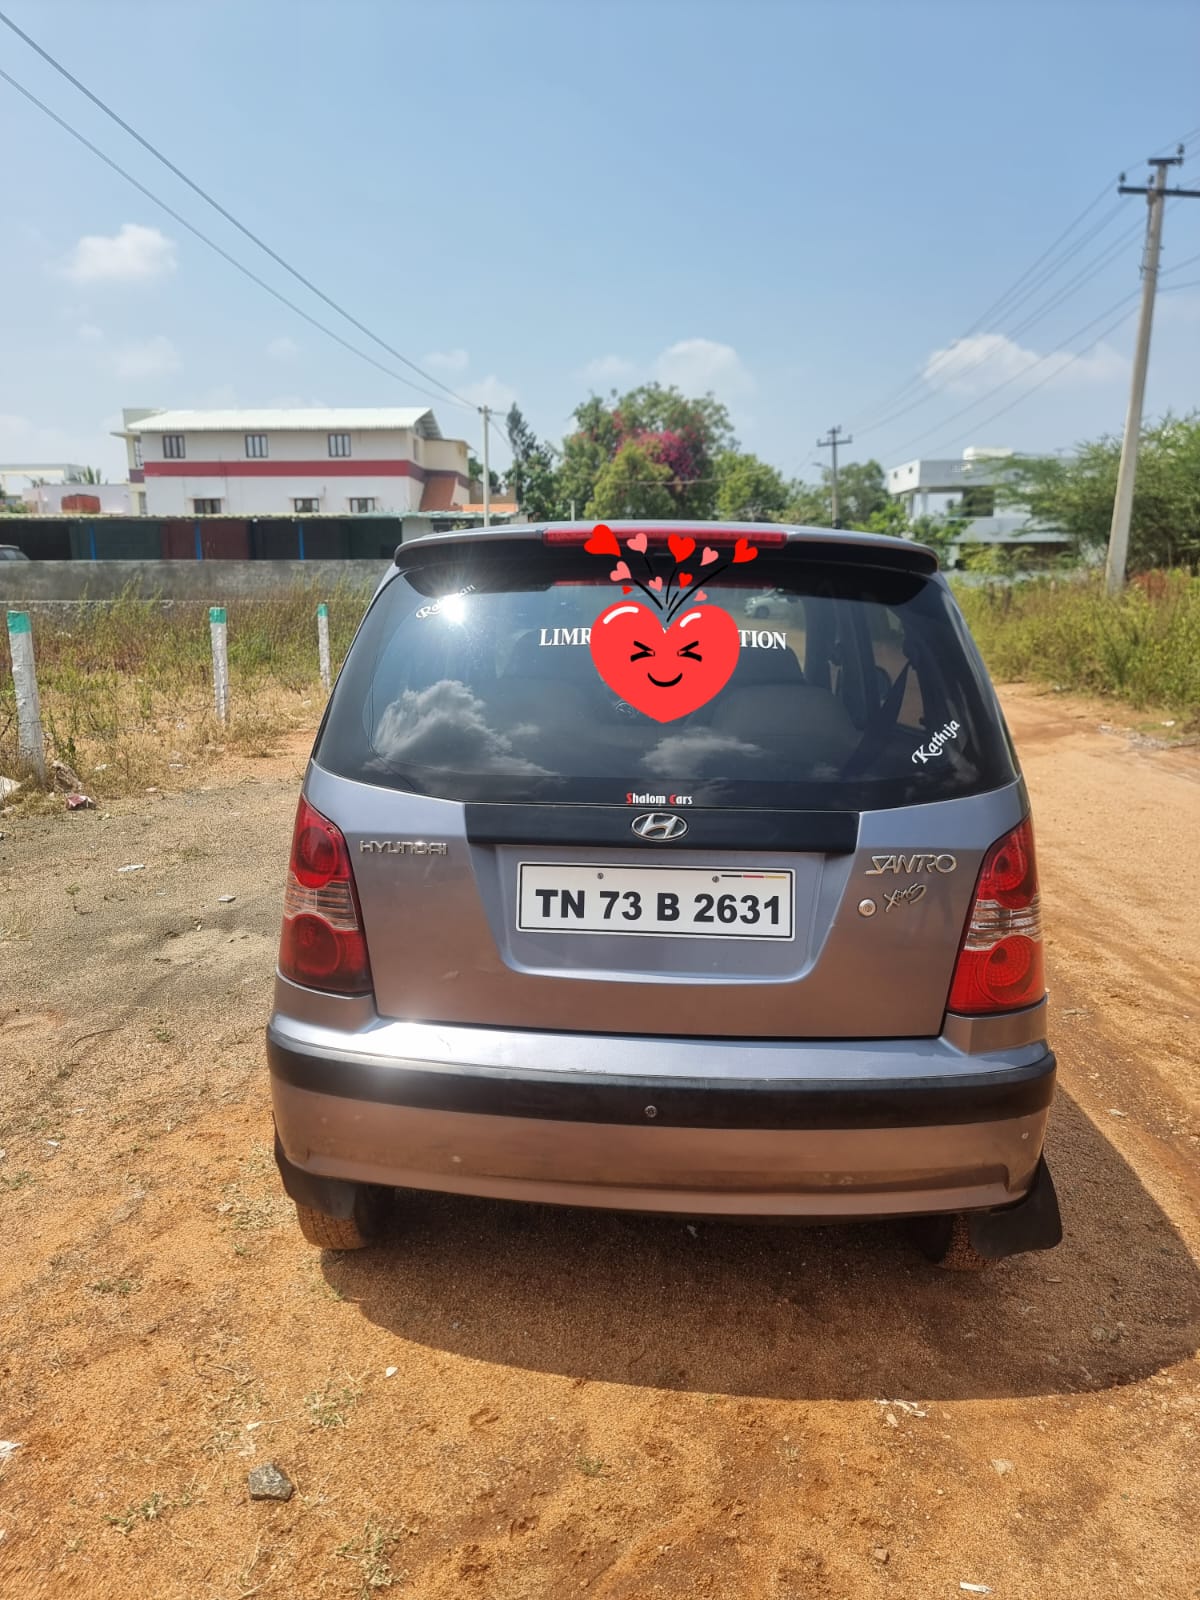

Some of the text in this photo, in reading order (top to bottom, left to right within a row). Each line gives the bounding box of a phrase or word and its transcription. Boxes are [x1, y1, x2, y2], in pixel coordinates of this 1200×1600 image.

[539, 627, 788, 650] LIMR TION
[911, 720, 960, 764] Kathija
[626, 791, 694, 806] Shalom Cars
[359, 840, 447, 855] HYUNDAI
[864, 853, 958, 875] SANTRO
[535, 889, 780, 925] TN 73 B 2631
